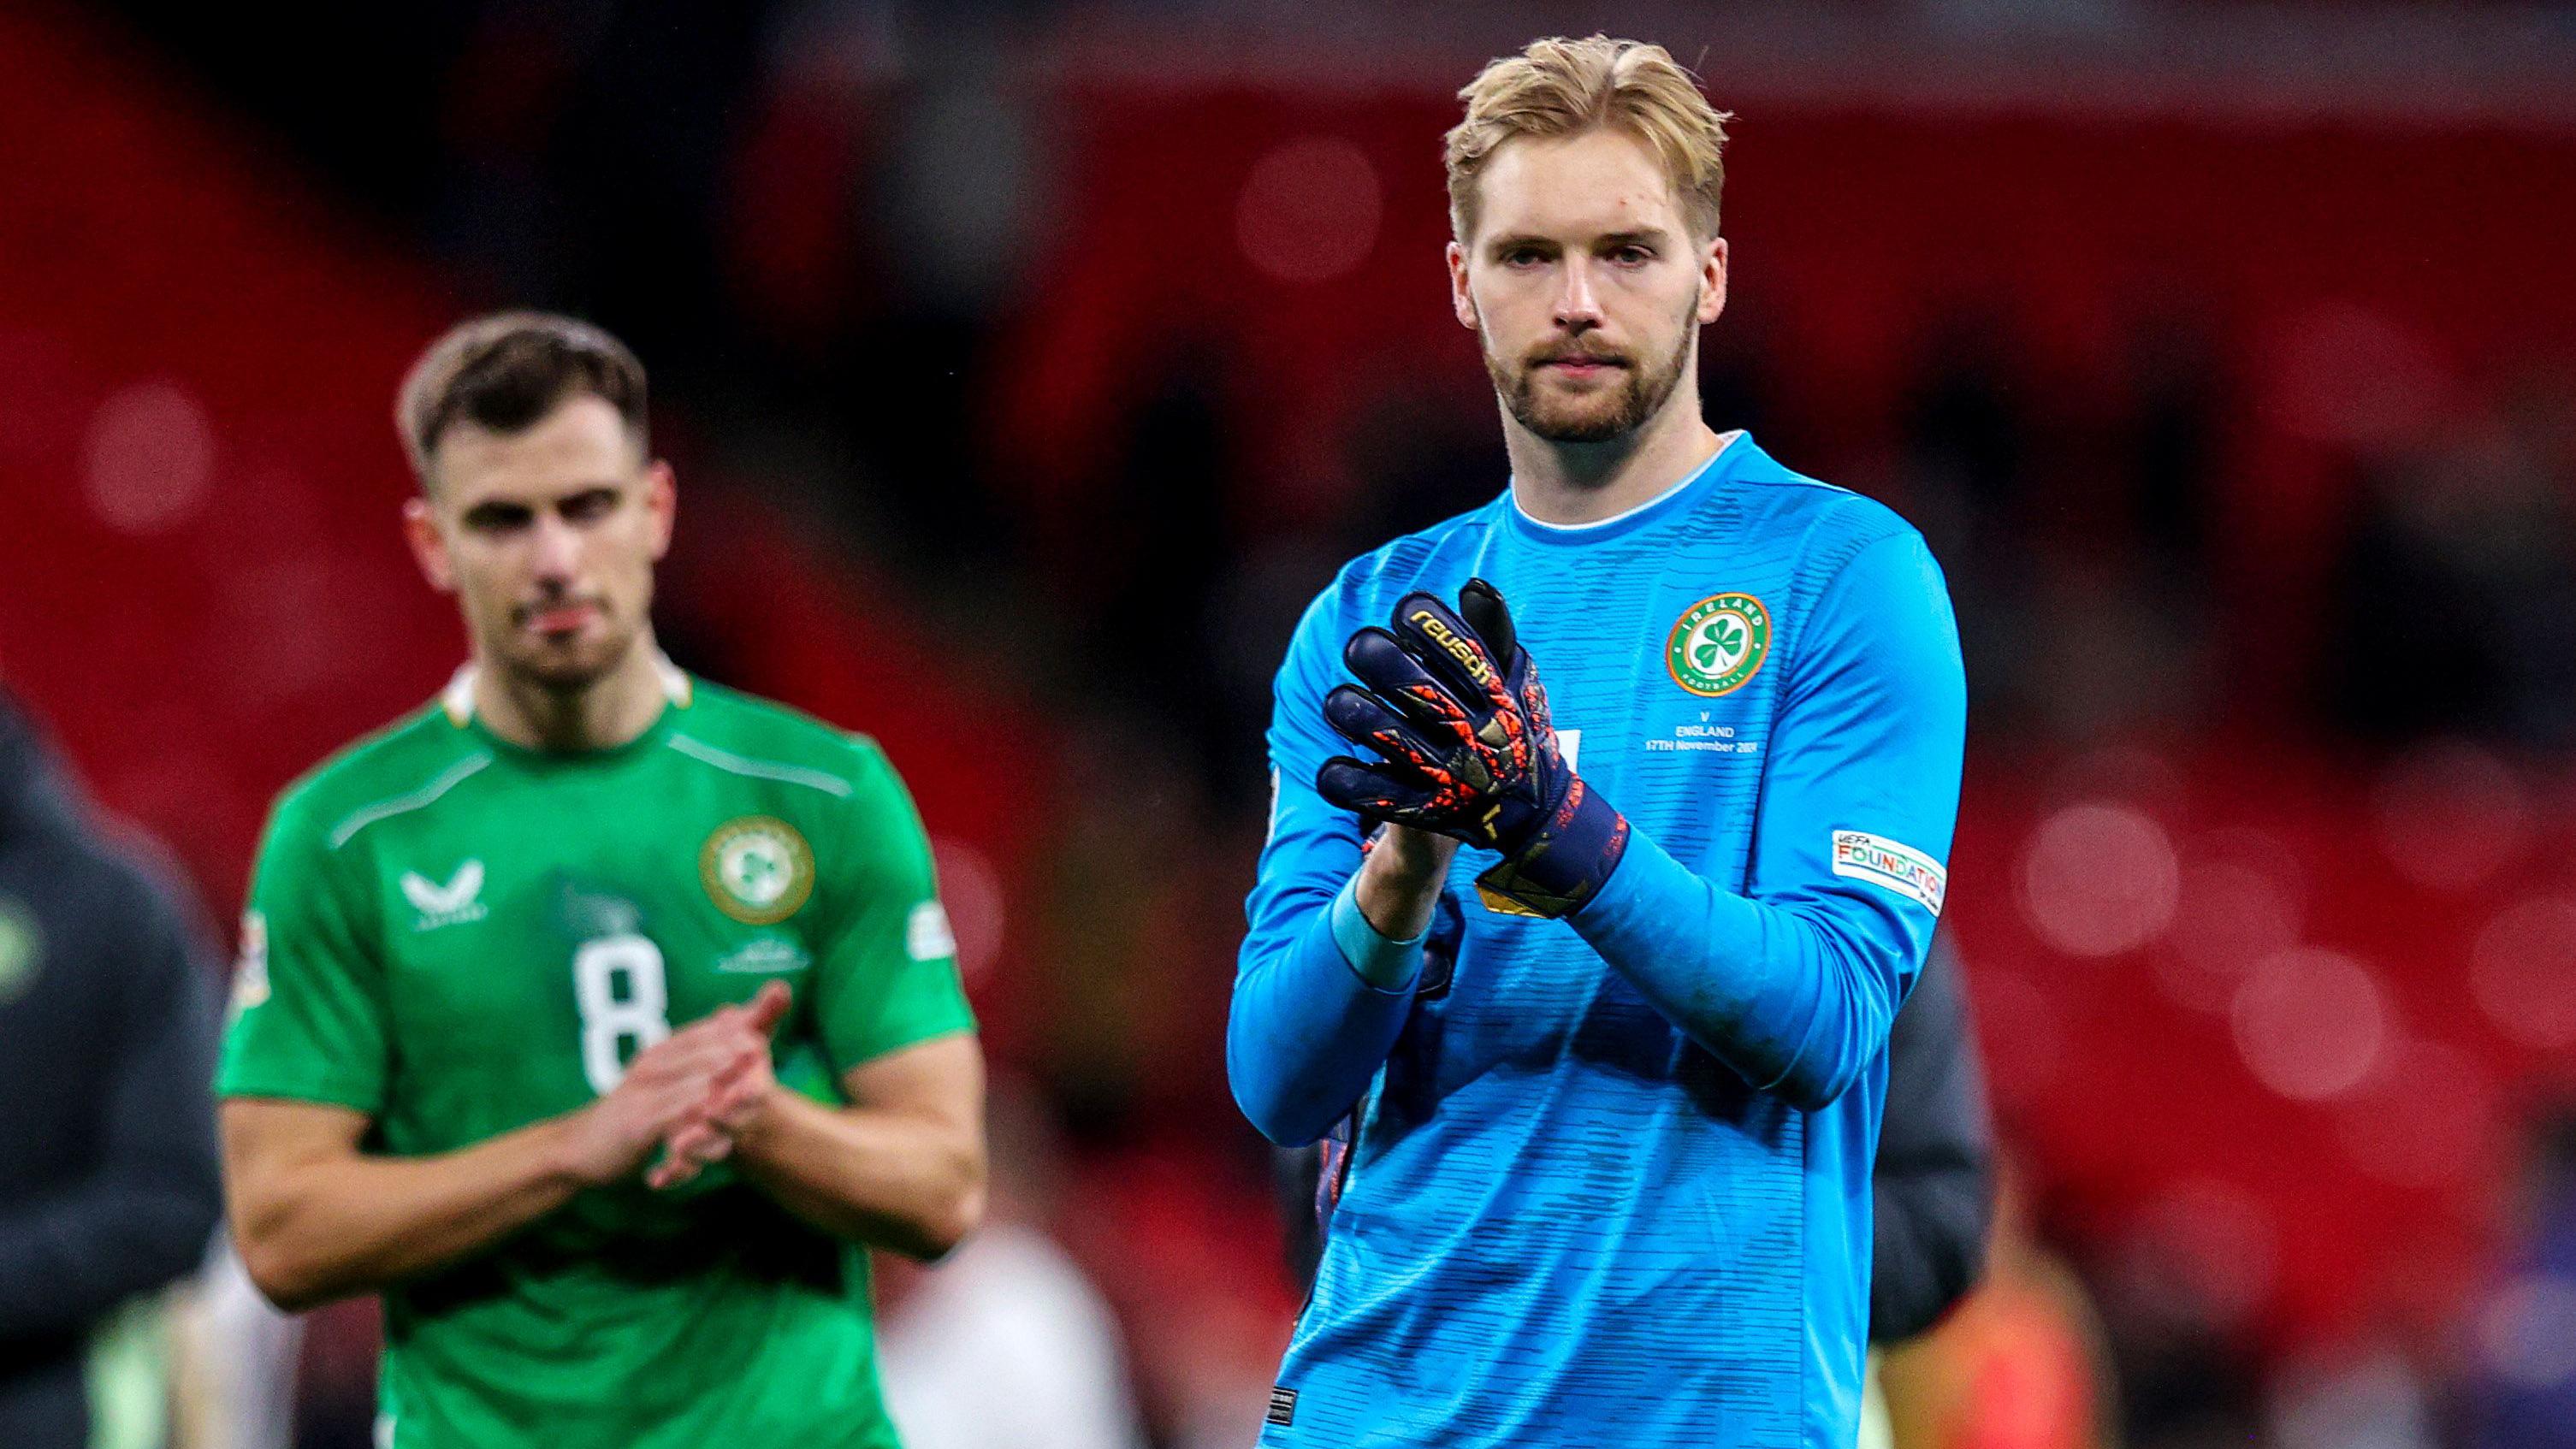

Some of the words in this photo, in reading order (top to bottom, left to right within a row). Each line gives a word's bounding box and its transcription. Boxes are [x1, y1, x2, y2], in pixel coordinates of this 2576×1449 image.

[1682, 598, 1763, 630] IRELAND
[1410, 610, 1491, 685] reusch
[1676, 725, 1735, 737] ENGLAND
[1645, 740, 1674, 751] 17TH
[1675, 740, 1735, 752] November
[1839, 834, 1870, 844] UEFA
[574, 935, 672, 1096] 8
